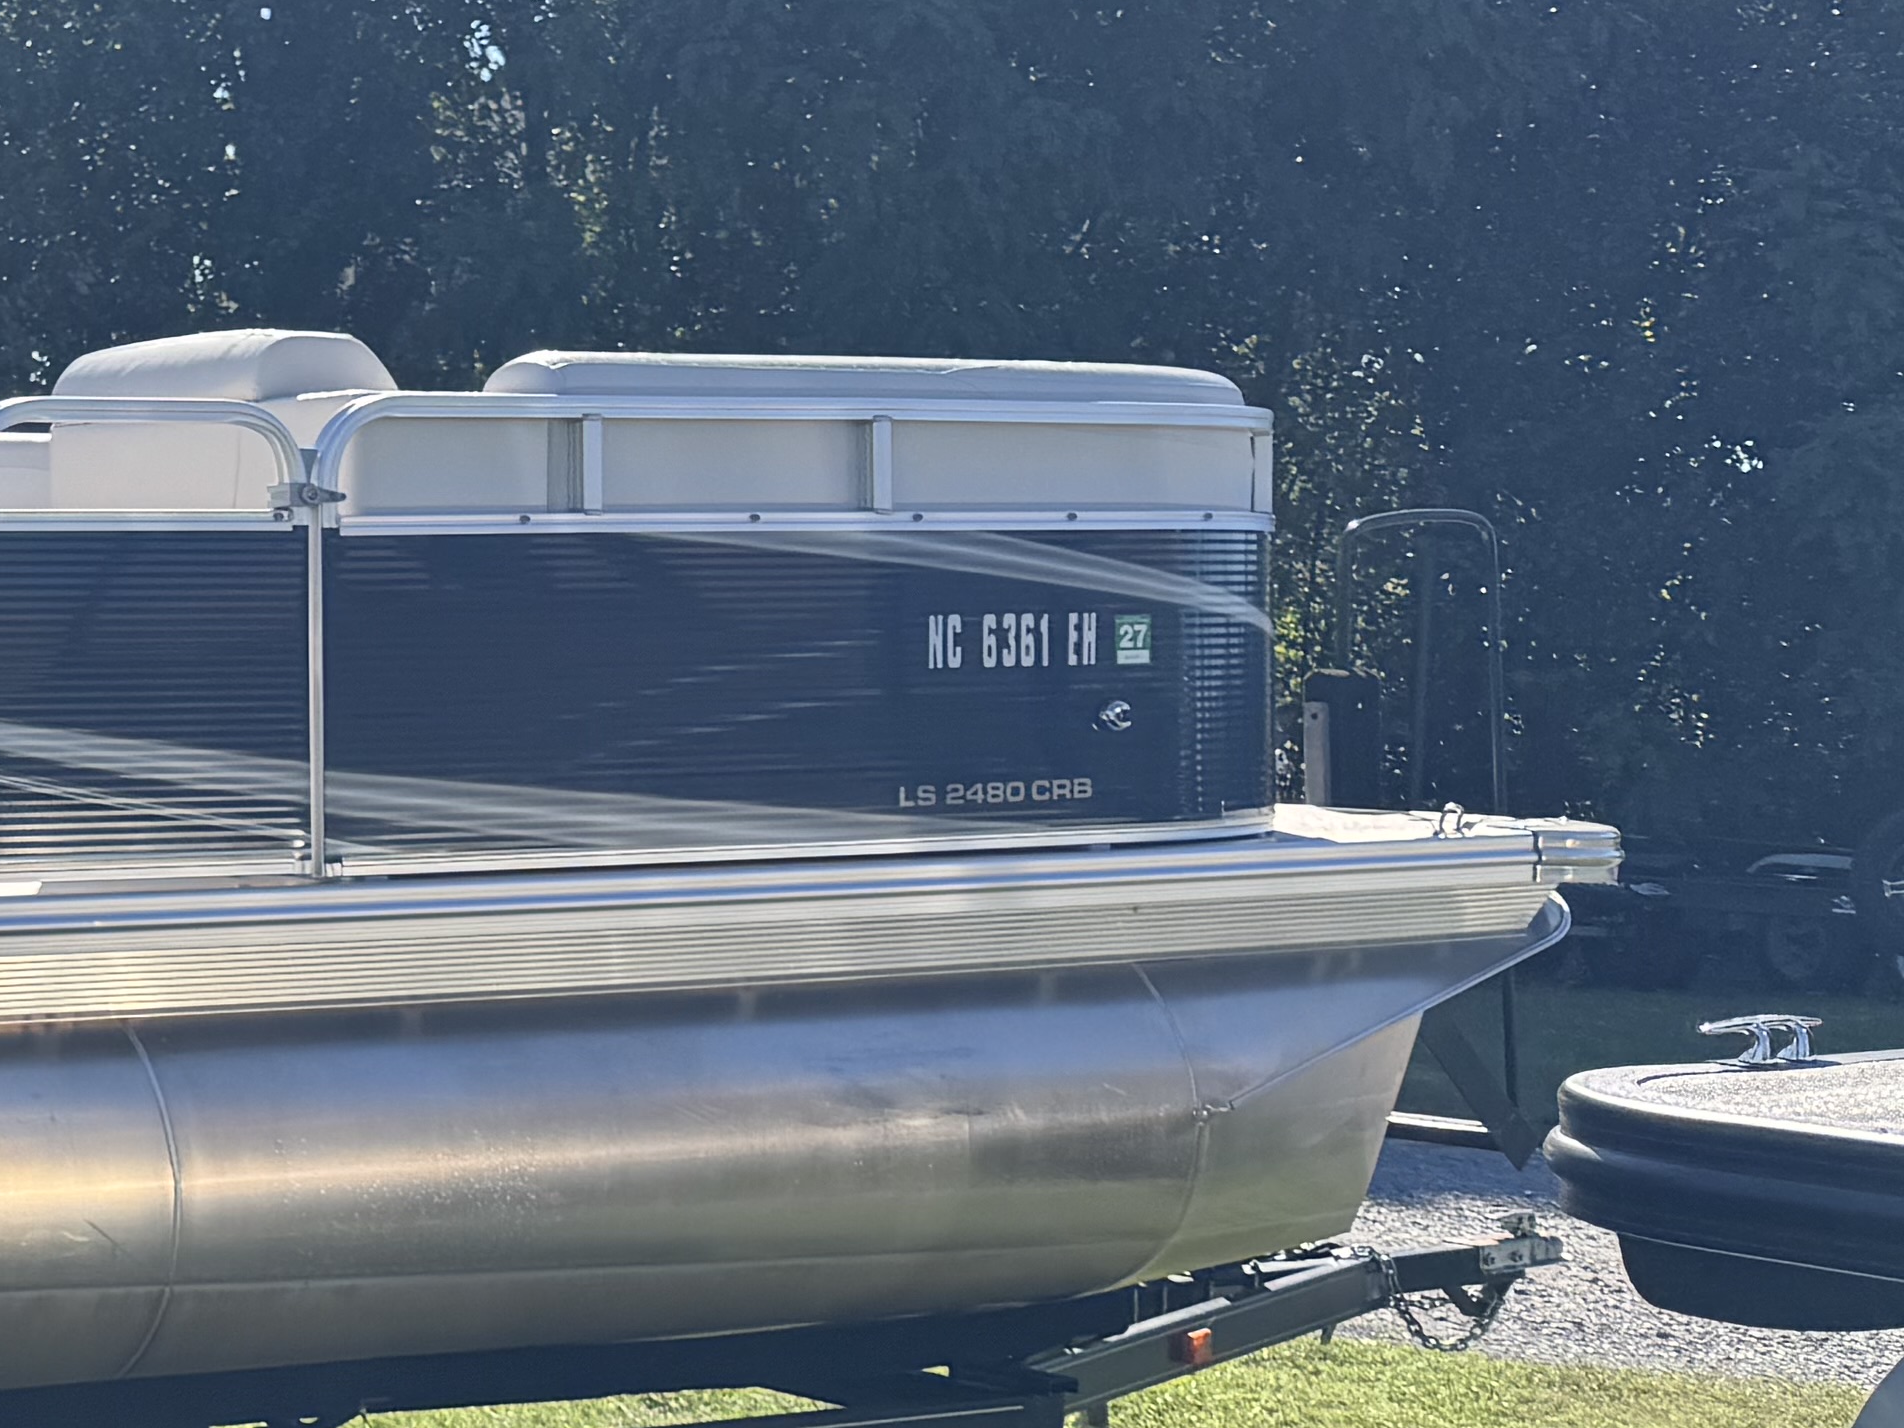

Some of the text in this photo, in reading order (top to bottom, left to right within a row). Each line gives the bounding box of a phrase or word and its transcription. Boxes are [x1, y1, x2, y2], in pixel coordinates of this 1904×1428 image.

[928, 612, 1097, 669] NC 6361 EH
[1119, 624, 1148, 648] 27
[899, 777, 1092, 807] LS 2480 CRB
